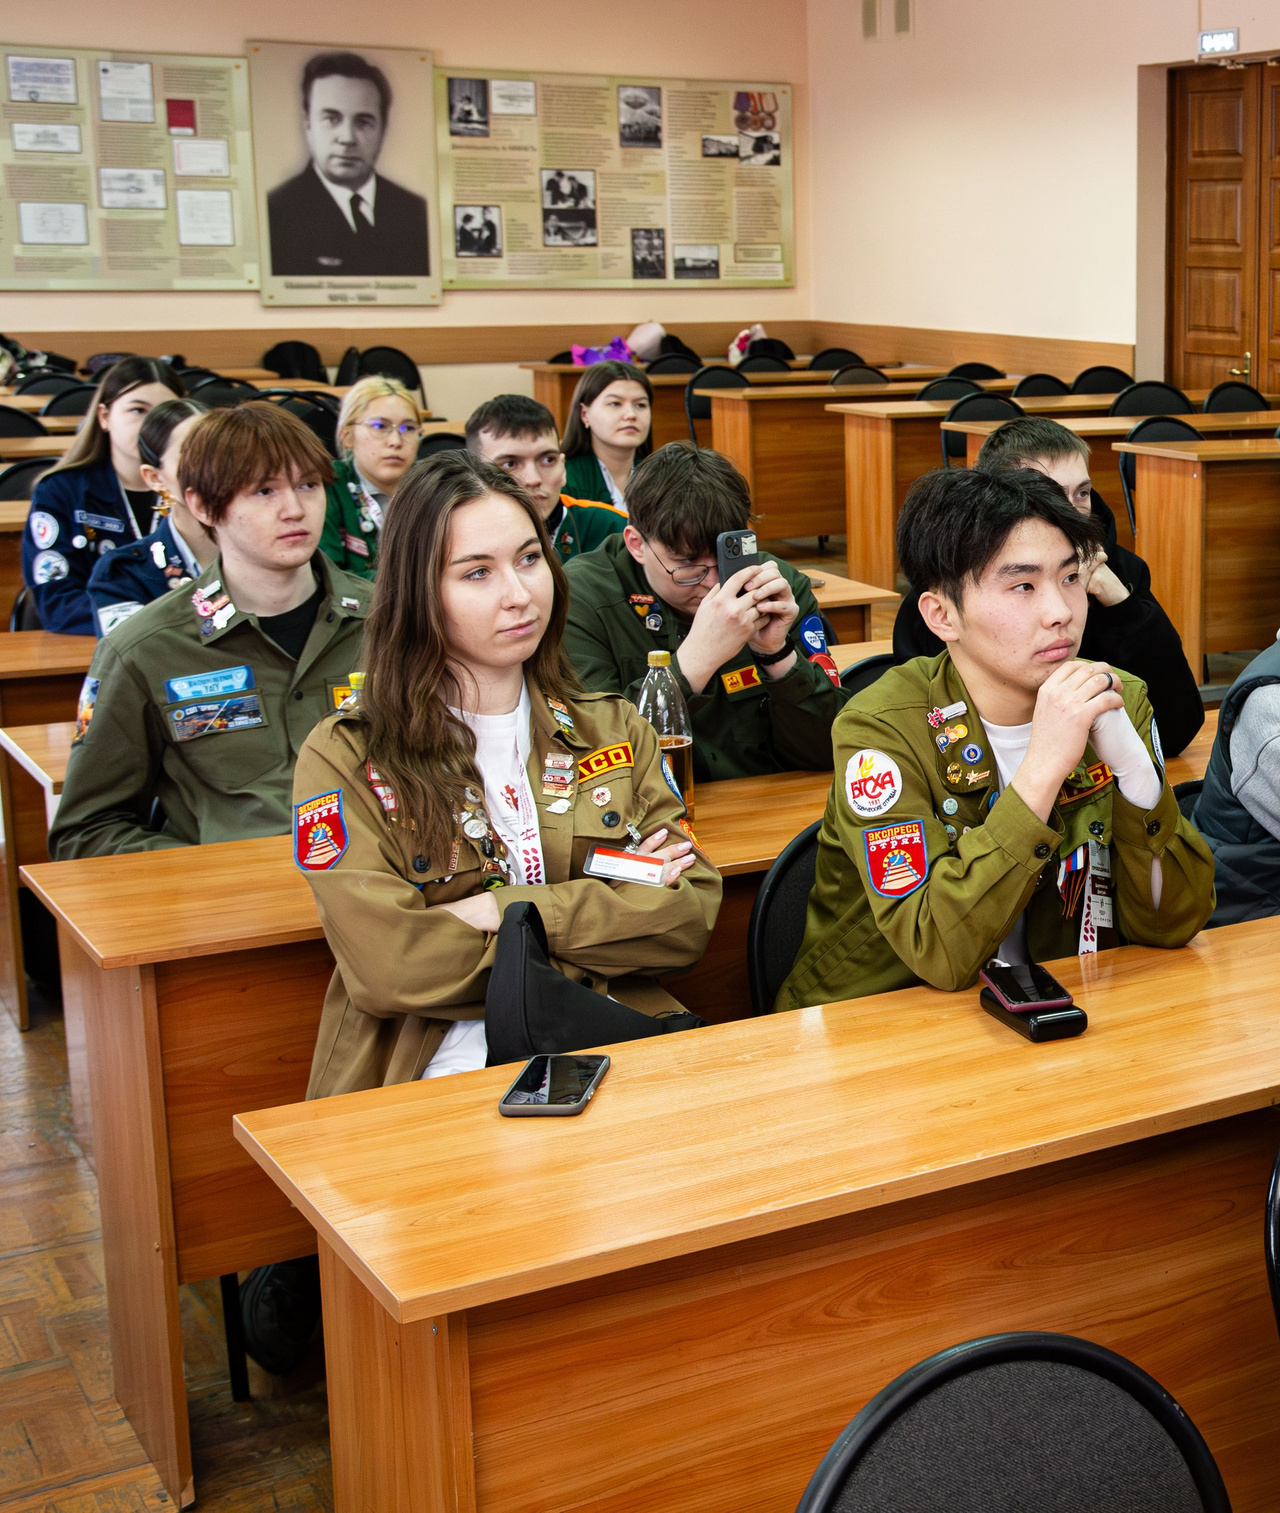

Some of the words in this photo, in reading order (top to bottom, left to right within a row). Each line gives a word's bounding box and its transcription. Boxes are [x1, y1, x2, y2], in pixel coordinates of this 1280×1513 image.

[851, 770, 895, 799] БГСХА
[298, 793, 338, 815] ЭКСПРЕСС
[868, 824, 918, 841] ЭКСПРЕСС
